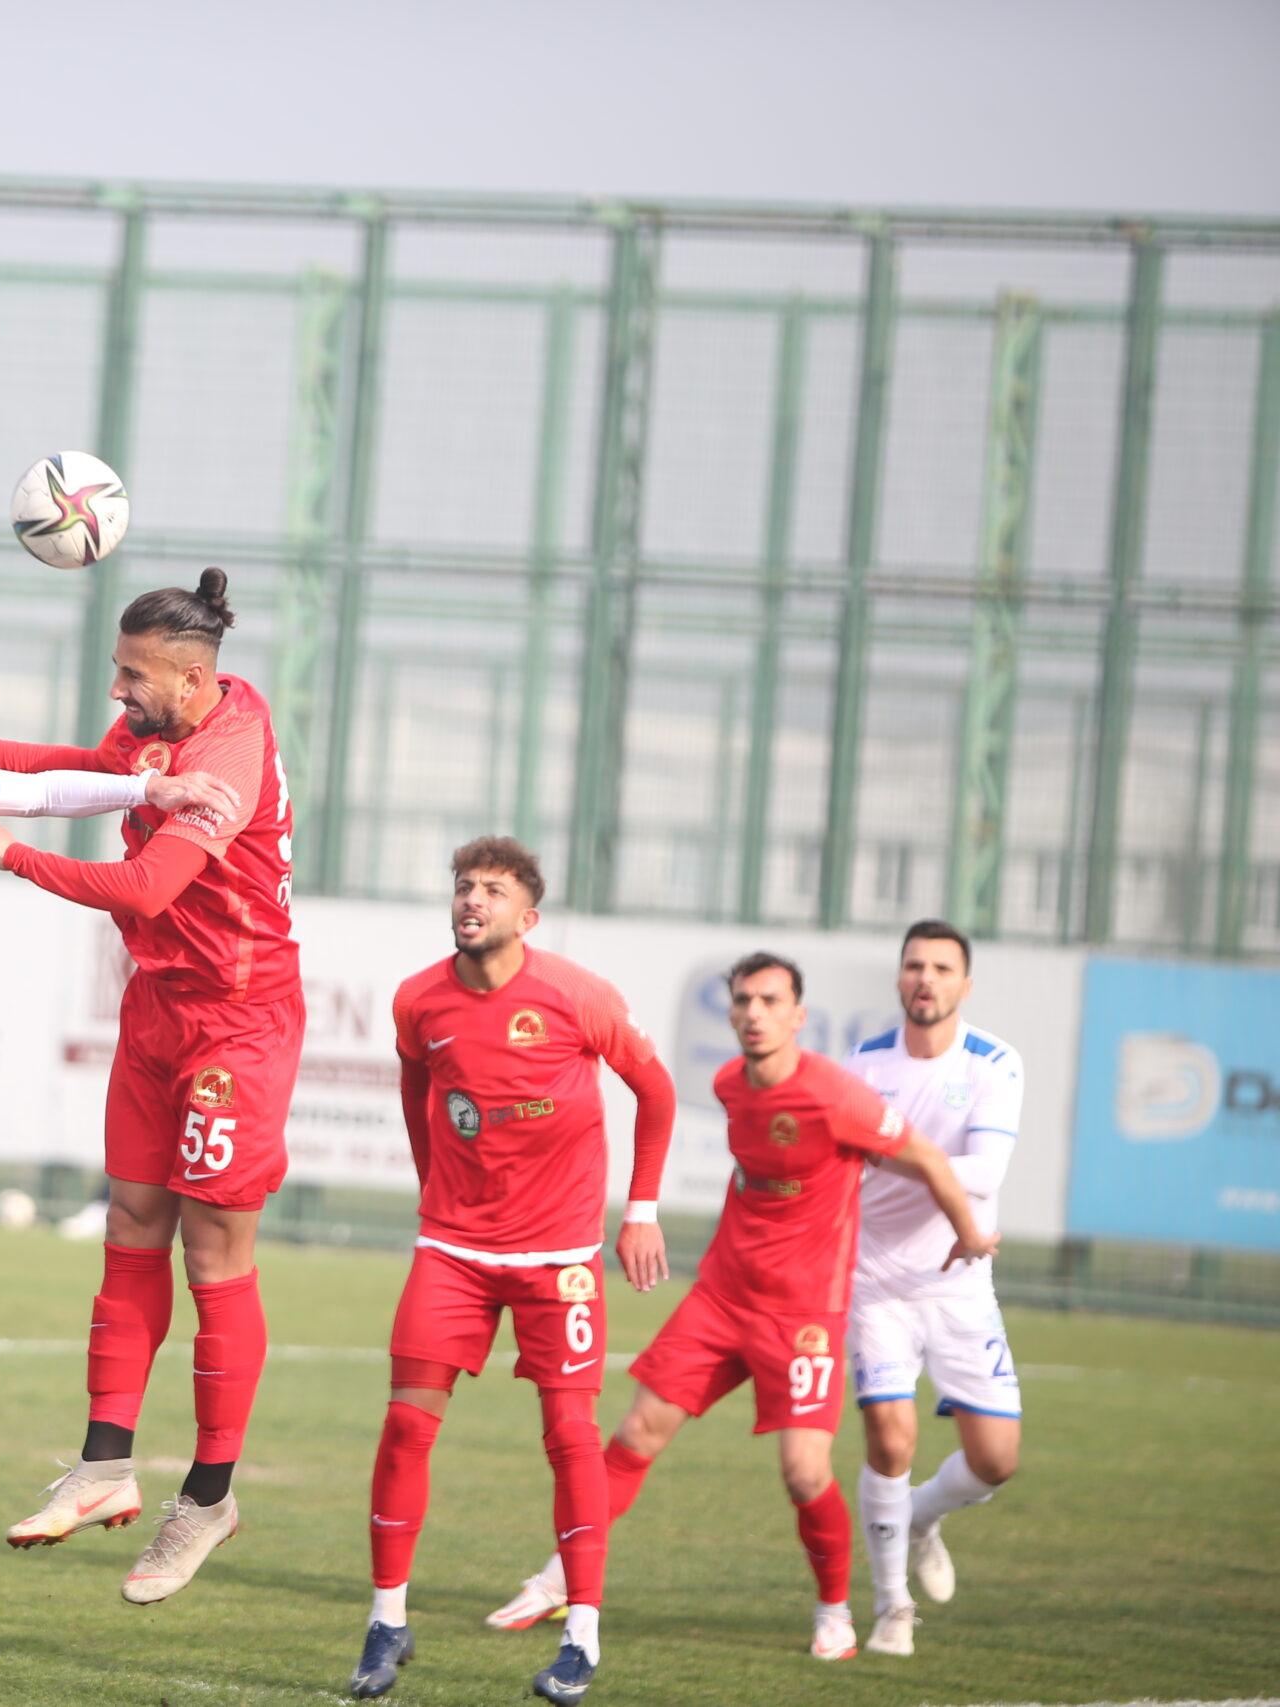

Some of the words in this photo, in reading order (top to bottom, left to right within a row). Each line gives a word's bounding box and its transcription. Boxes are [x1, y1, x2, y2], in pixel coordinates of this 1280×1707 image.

[181, 1110, 237, 1171] 55
[565, 1303, 594, 1354] 6
[788, 1355, 835, 1400] 97
[985, 1336, 1012, 1378] 2
